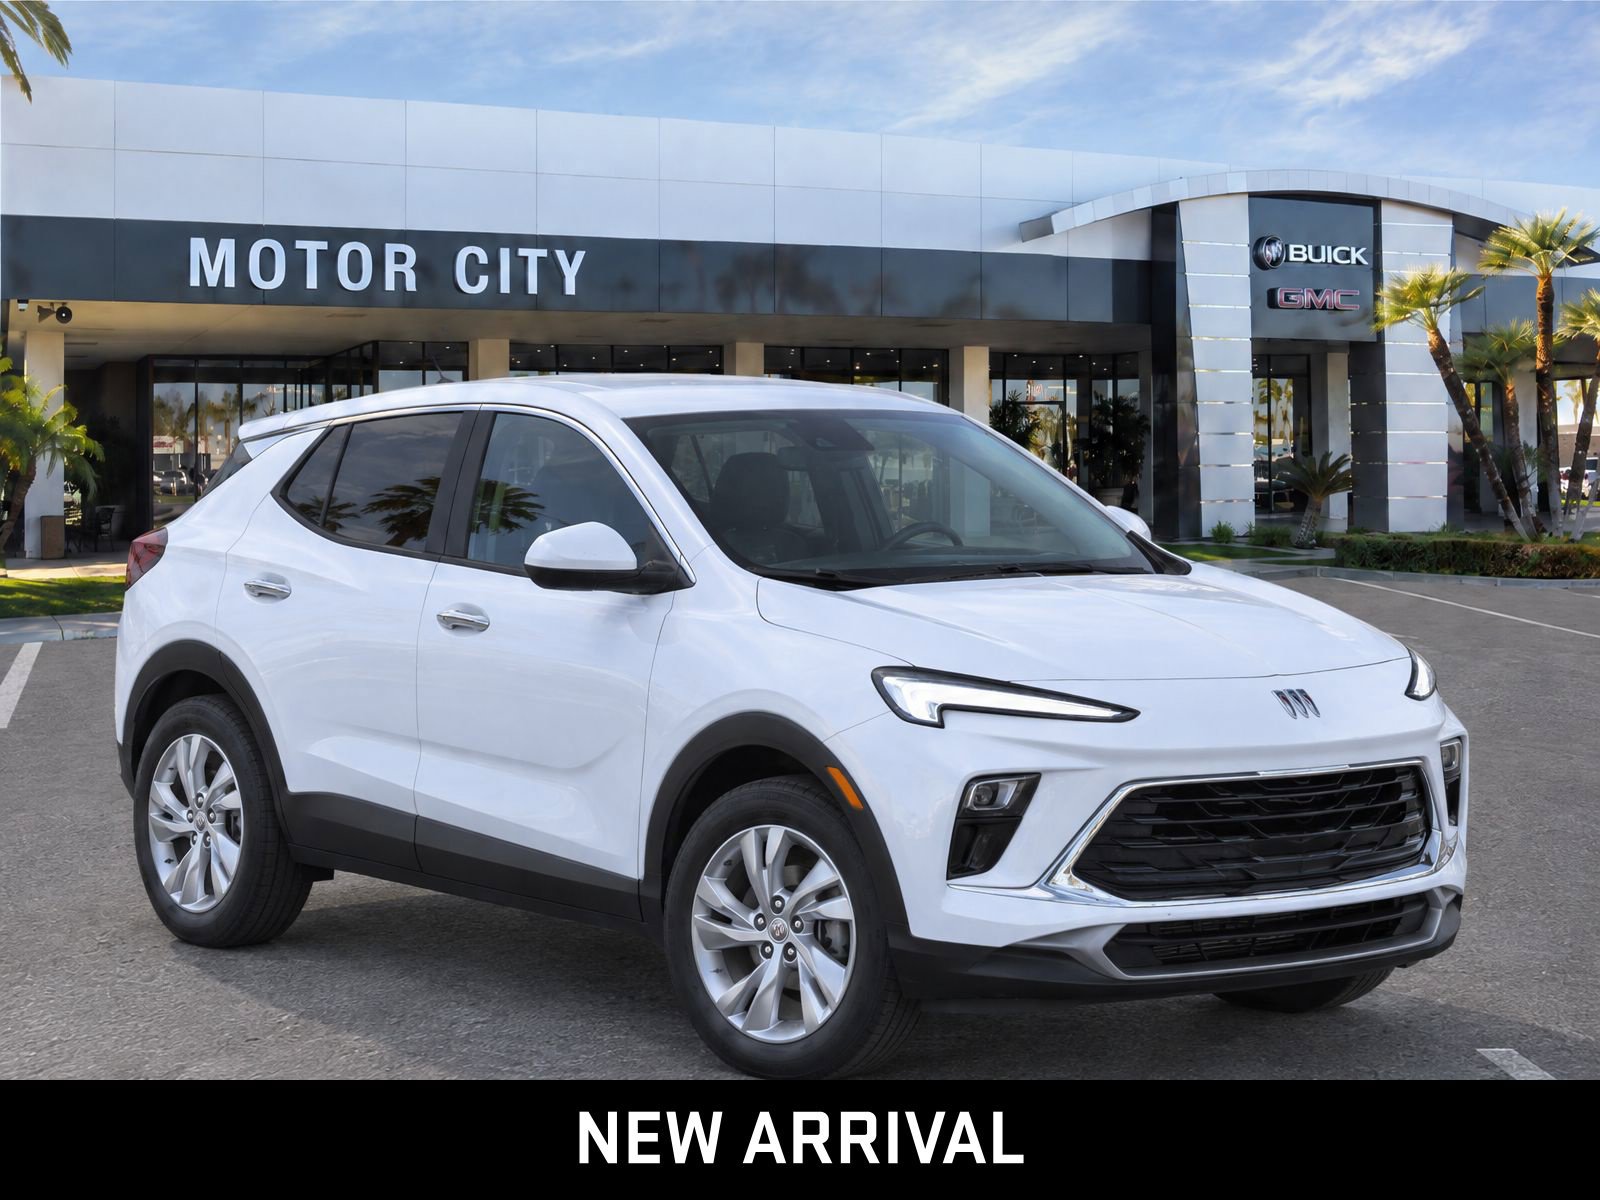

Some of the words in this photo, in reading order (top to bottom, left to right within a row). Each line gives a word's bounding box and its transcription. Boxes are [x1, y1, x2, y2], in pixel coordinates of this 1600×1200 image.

[1288, 244, 1369, 265] BUICK
[189, 237, 418, 292] MOTOR
[454, 245, 586, 296] CITY
[1277, 287, 1360, 310] GMC
